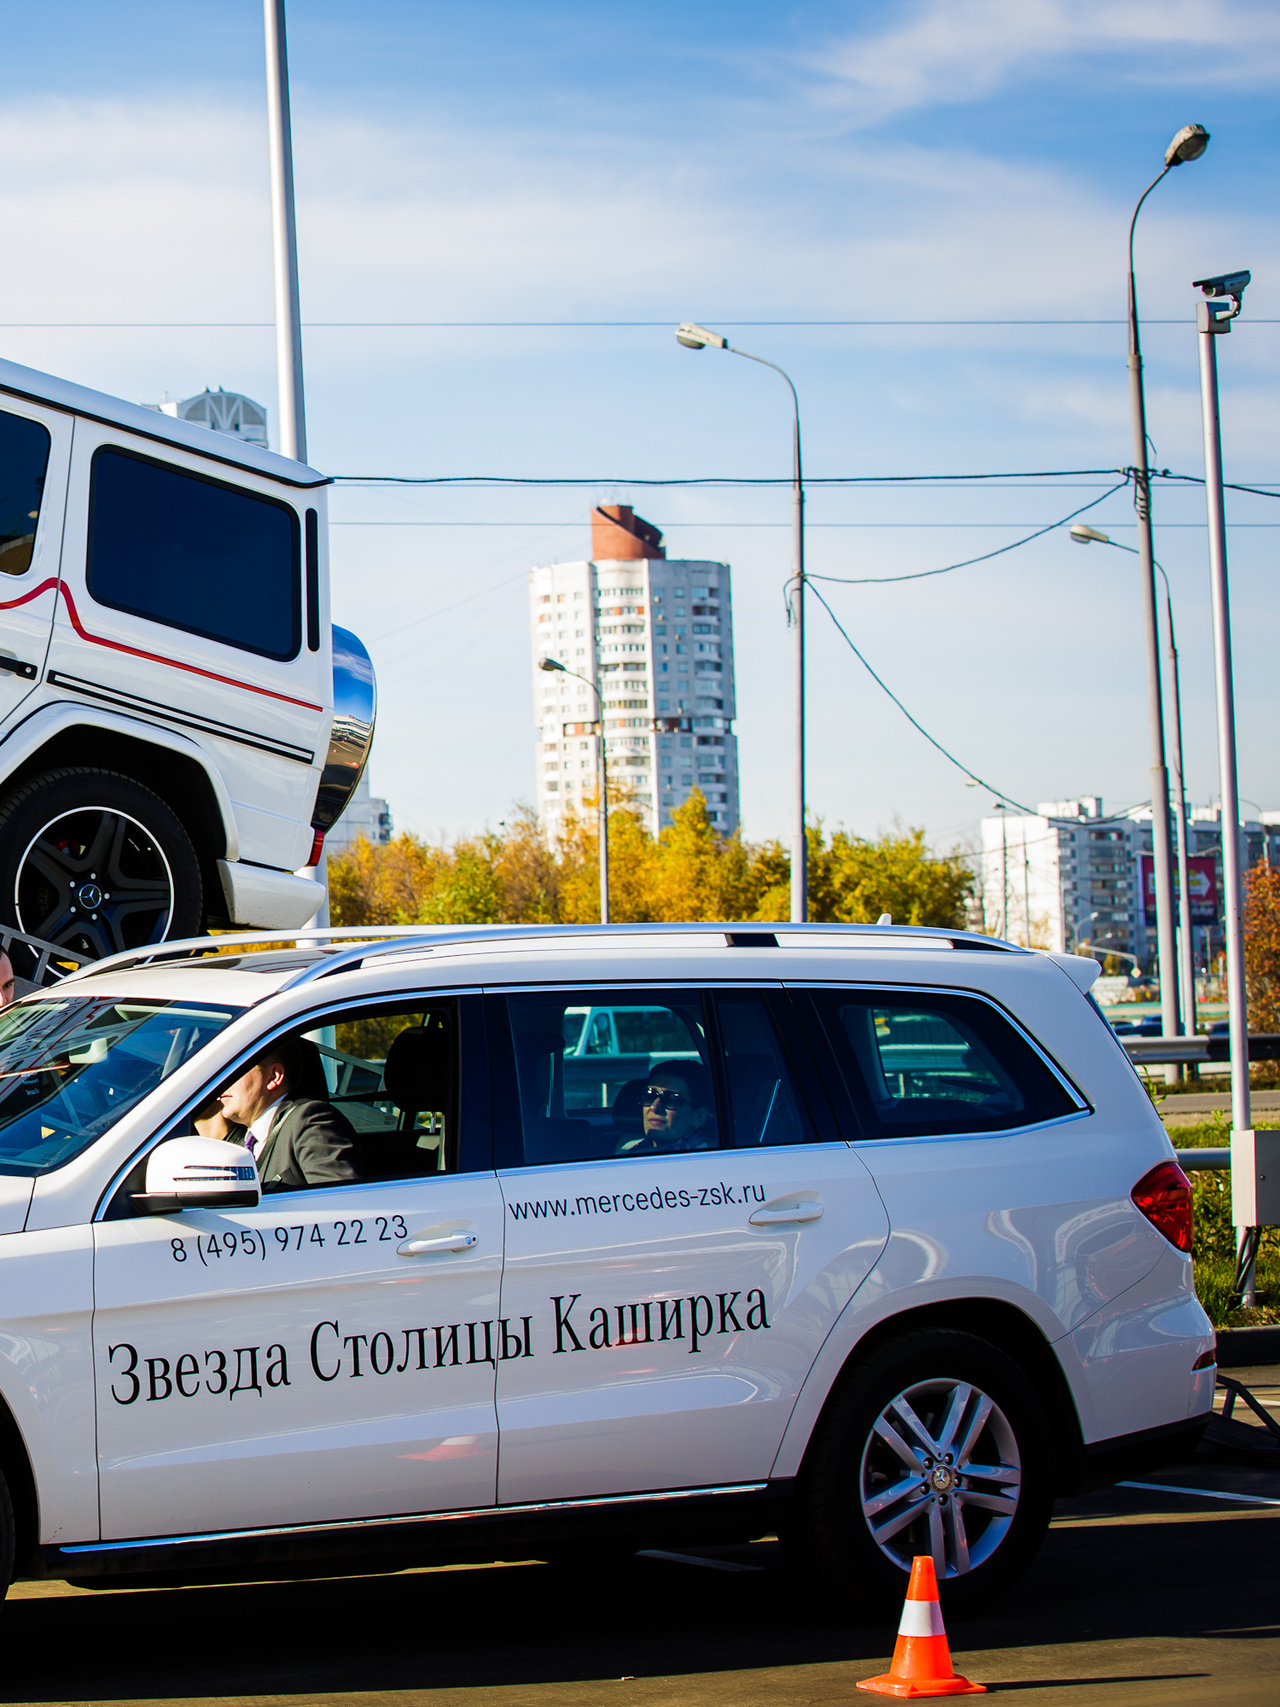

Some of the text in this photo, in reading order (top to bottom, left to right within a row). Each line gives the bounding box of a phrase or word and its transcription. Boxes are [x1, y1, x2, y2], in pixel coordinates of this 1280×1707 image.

[508, 1181, 766, 1221] www.mercedes-zsk.ru
[171, 1214, 409, 1267] 8 (495) 974 22 23
[108, 1286, 772, 1406] Звезда Столицы Каширка
